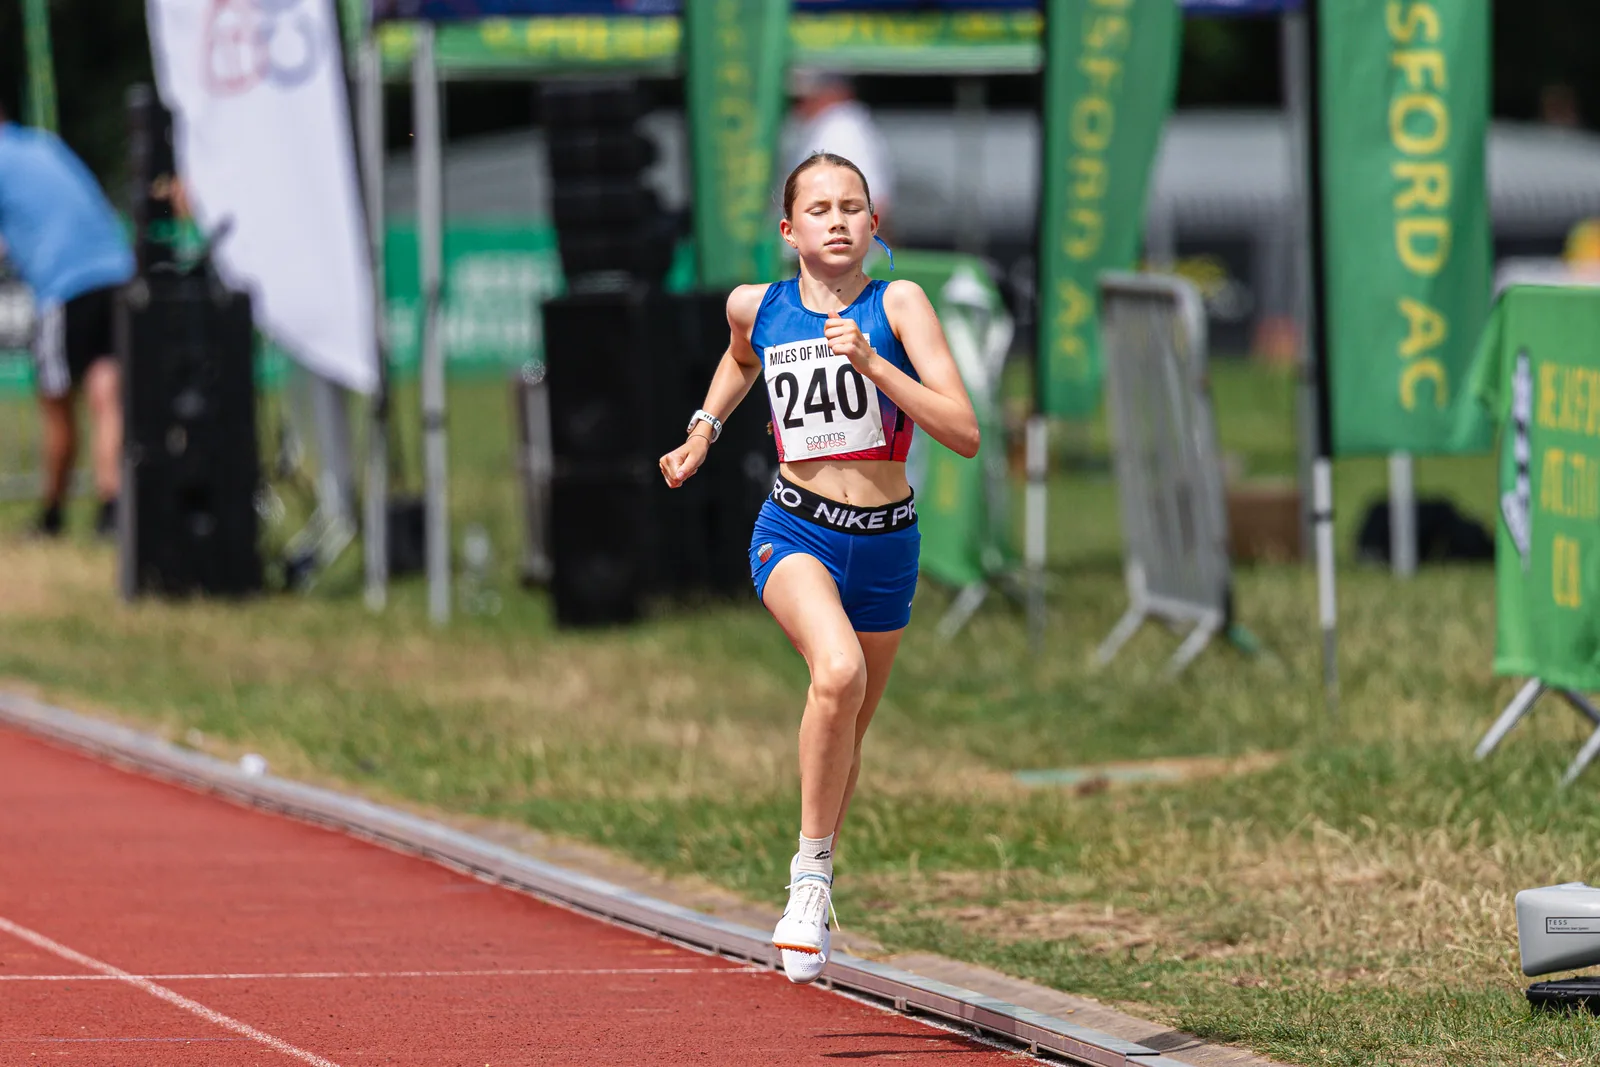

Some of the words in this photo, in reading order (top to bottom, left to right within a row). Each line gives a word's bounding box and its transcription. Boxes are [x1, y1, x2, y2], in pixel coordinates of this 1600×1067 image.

[1063, 0, 1131, 260] SFORD
[769, 348, 797, 366] MILES
[800, 346, 812, 361] OF
[815, 344, 834, 359] MIL
[1398, 297, 1449, 412] AC
[774, 363, 868, 430] 240
[806, 431, 845, 445] comms
[807, 438, 847, 451] express
[813, 502, 887, 530] NIKE
